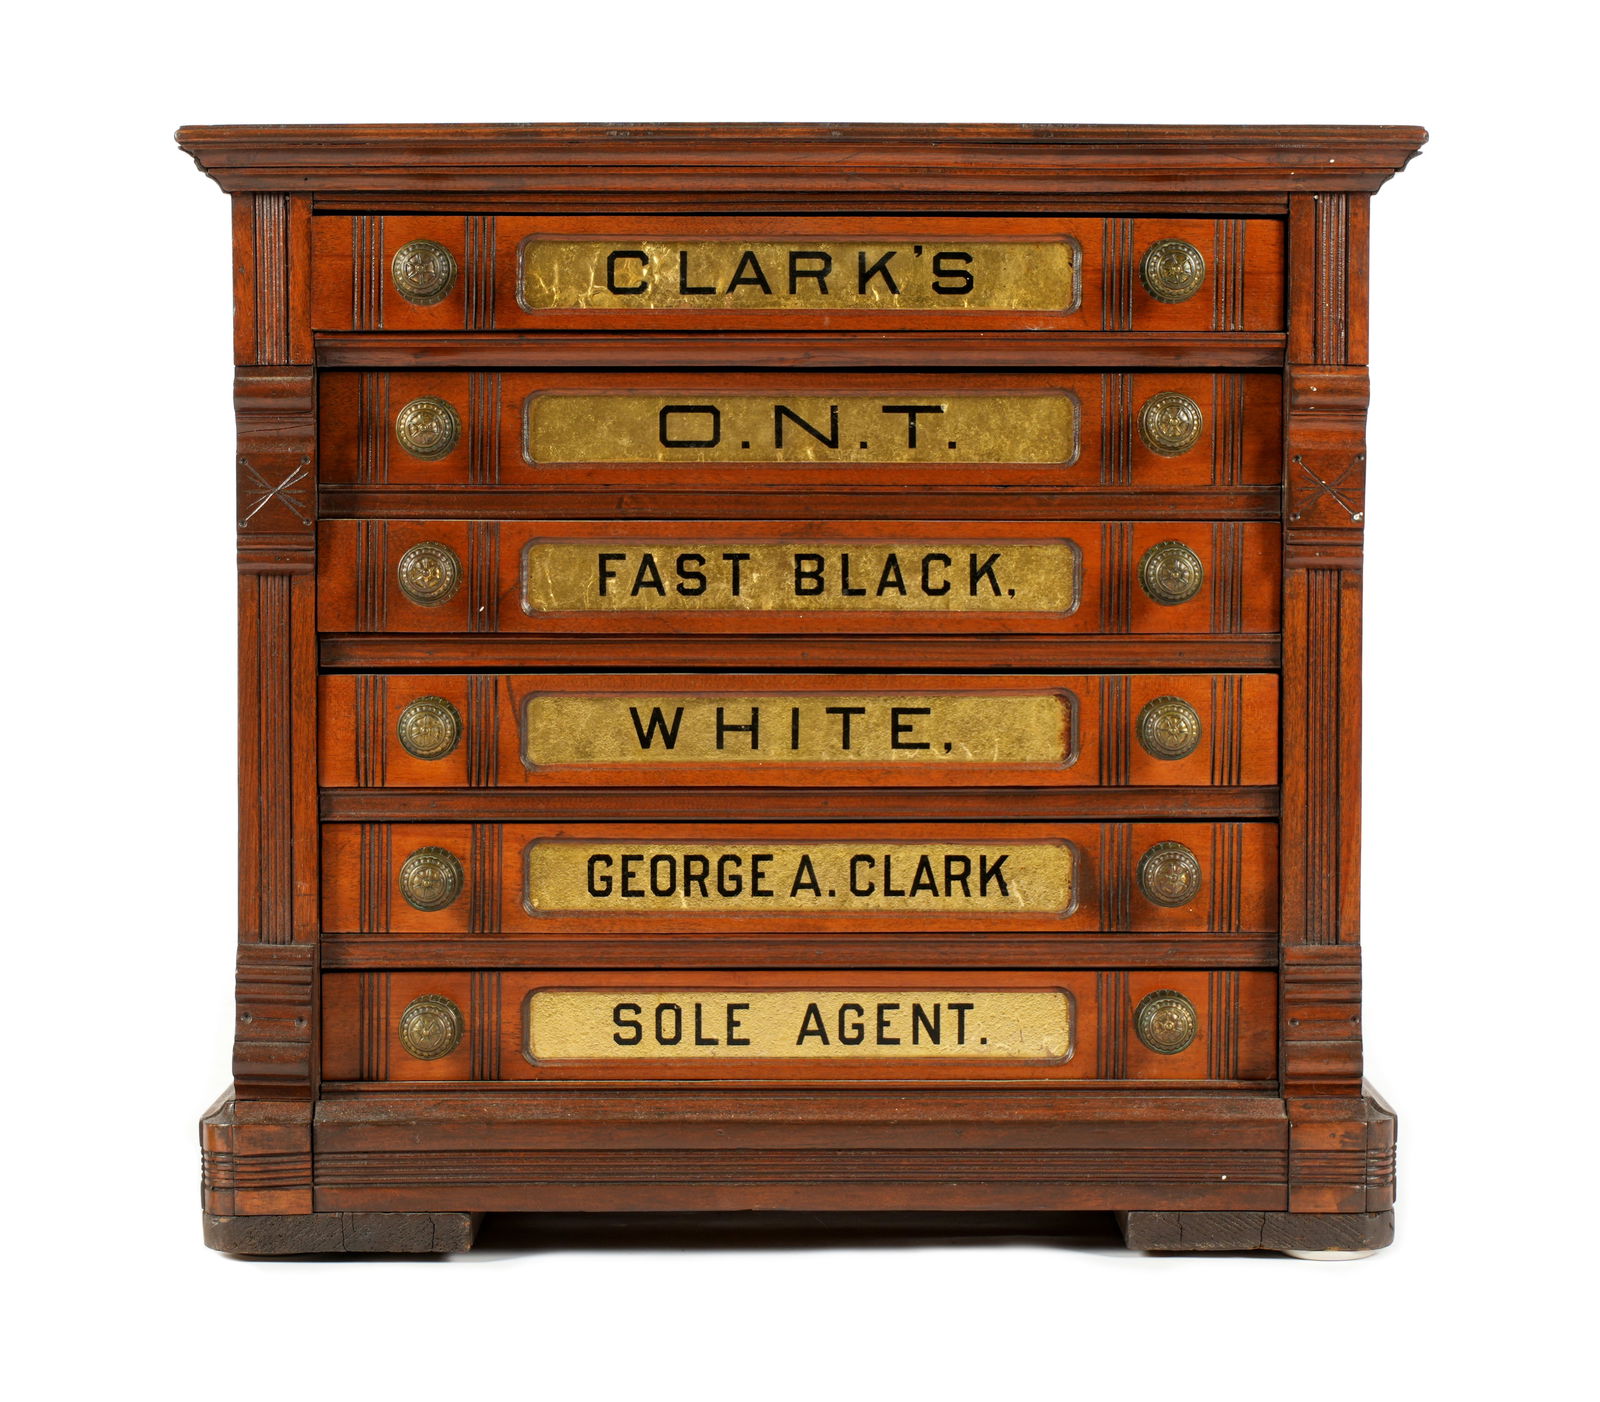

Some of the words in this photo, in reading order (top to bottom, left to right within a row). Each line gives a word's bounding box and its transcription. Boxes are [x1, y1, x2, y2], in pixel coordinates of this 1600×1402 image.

[606, 245, 974, 295] CLARK'S
[659, 404, 957, 449] O.N.T.
[598, 553, 751, 597] FAST
[794, 553, 1018, 599] BLACK,
[629, 706, 953, 755] WHITE,
[587, 853, 774, 898] GEORGE
[790, 854, 837, 898] A.
[850, 854, 1009, 898] CLARK
[612, 1002, 750, 1047] SOLE
[796, 1002, 989, 1046] AGENT.
